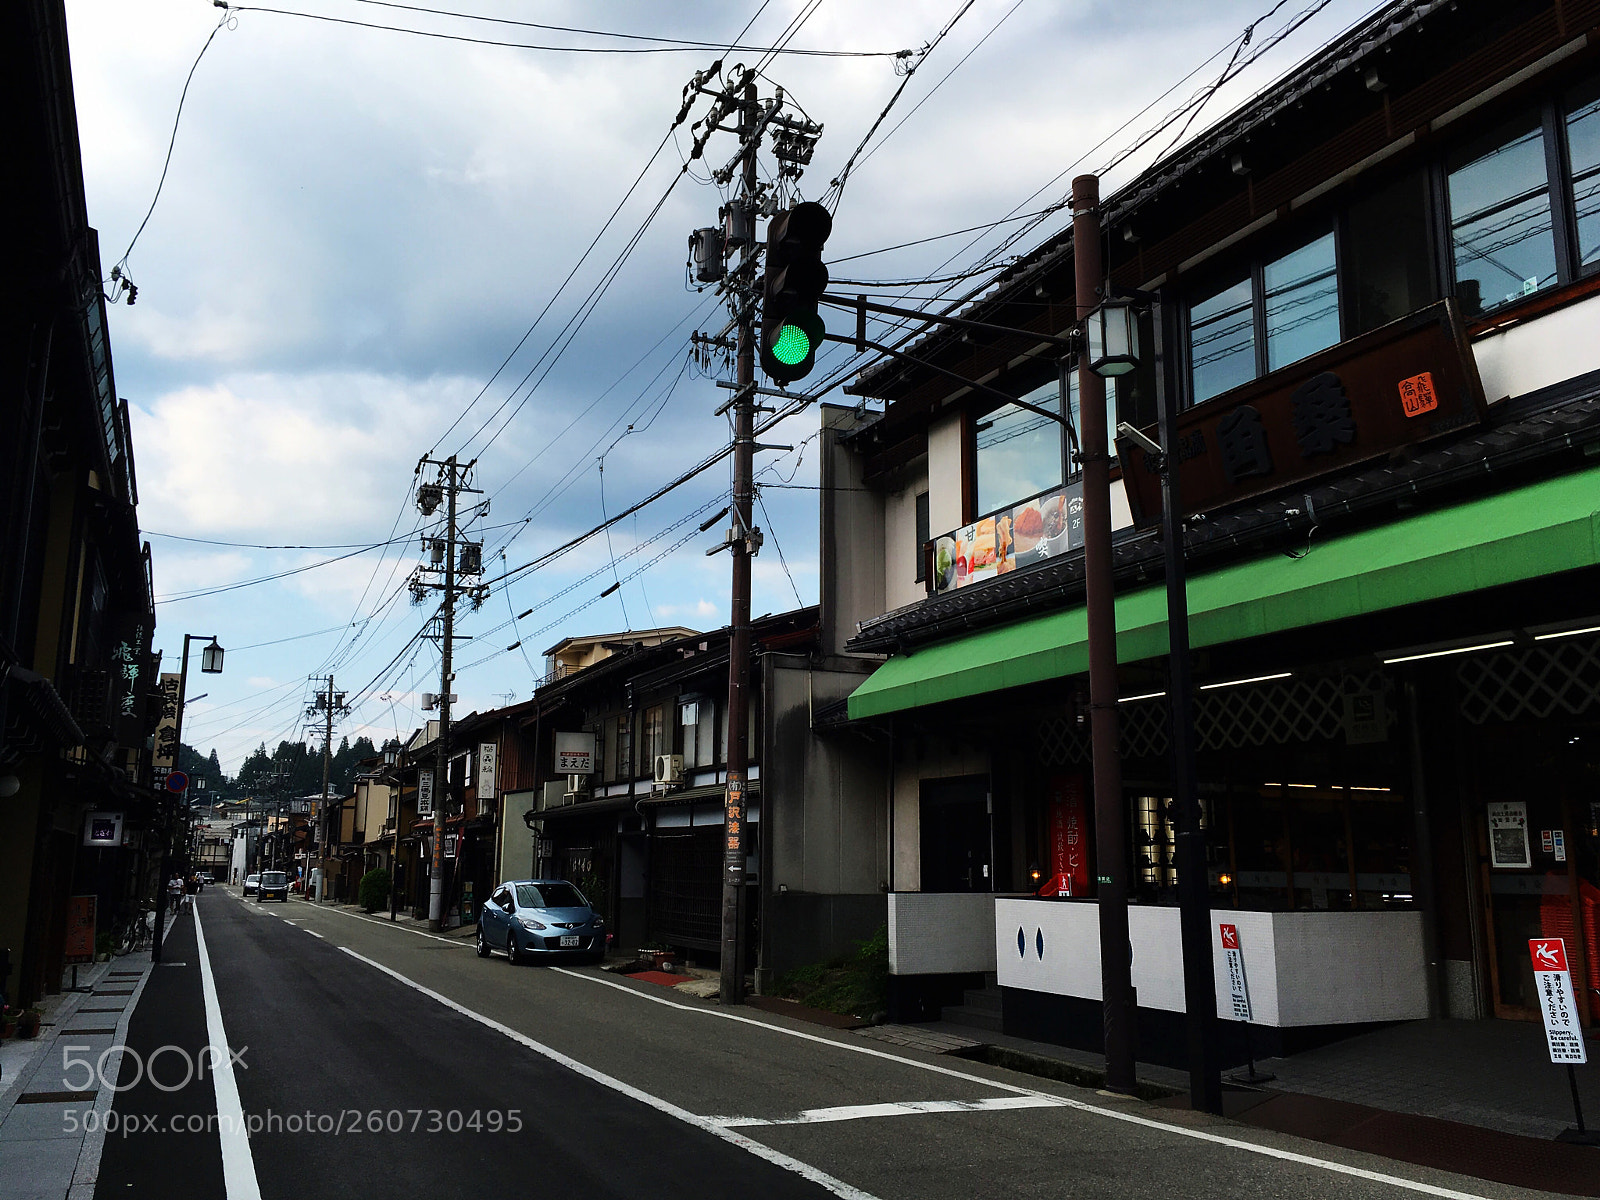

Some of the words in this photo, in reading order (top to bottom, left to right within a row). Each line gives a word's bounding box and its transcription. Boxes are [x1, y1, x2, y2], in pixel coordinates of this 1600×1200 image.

[1072, 518, 1081, 529] 2F
[965, 526, 976, 542] 甘
[560, 757, 590, 768] まえだ
[1543, 975, 1559, 1025] ご注意ください
[1553, 974, 1570, 1026] 滑りやすいので
